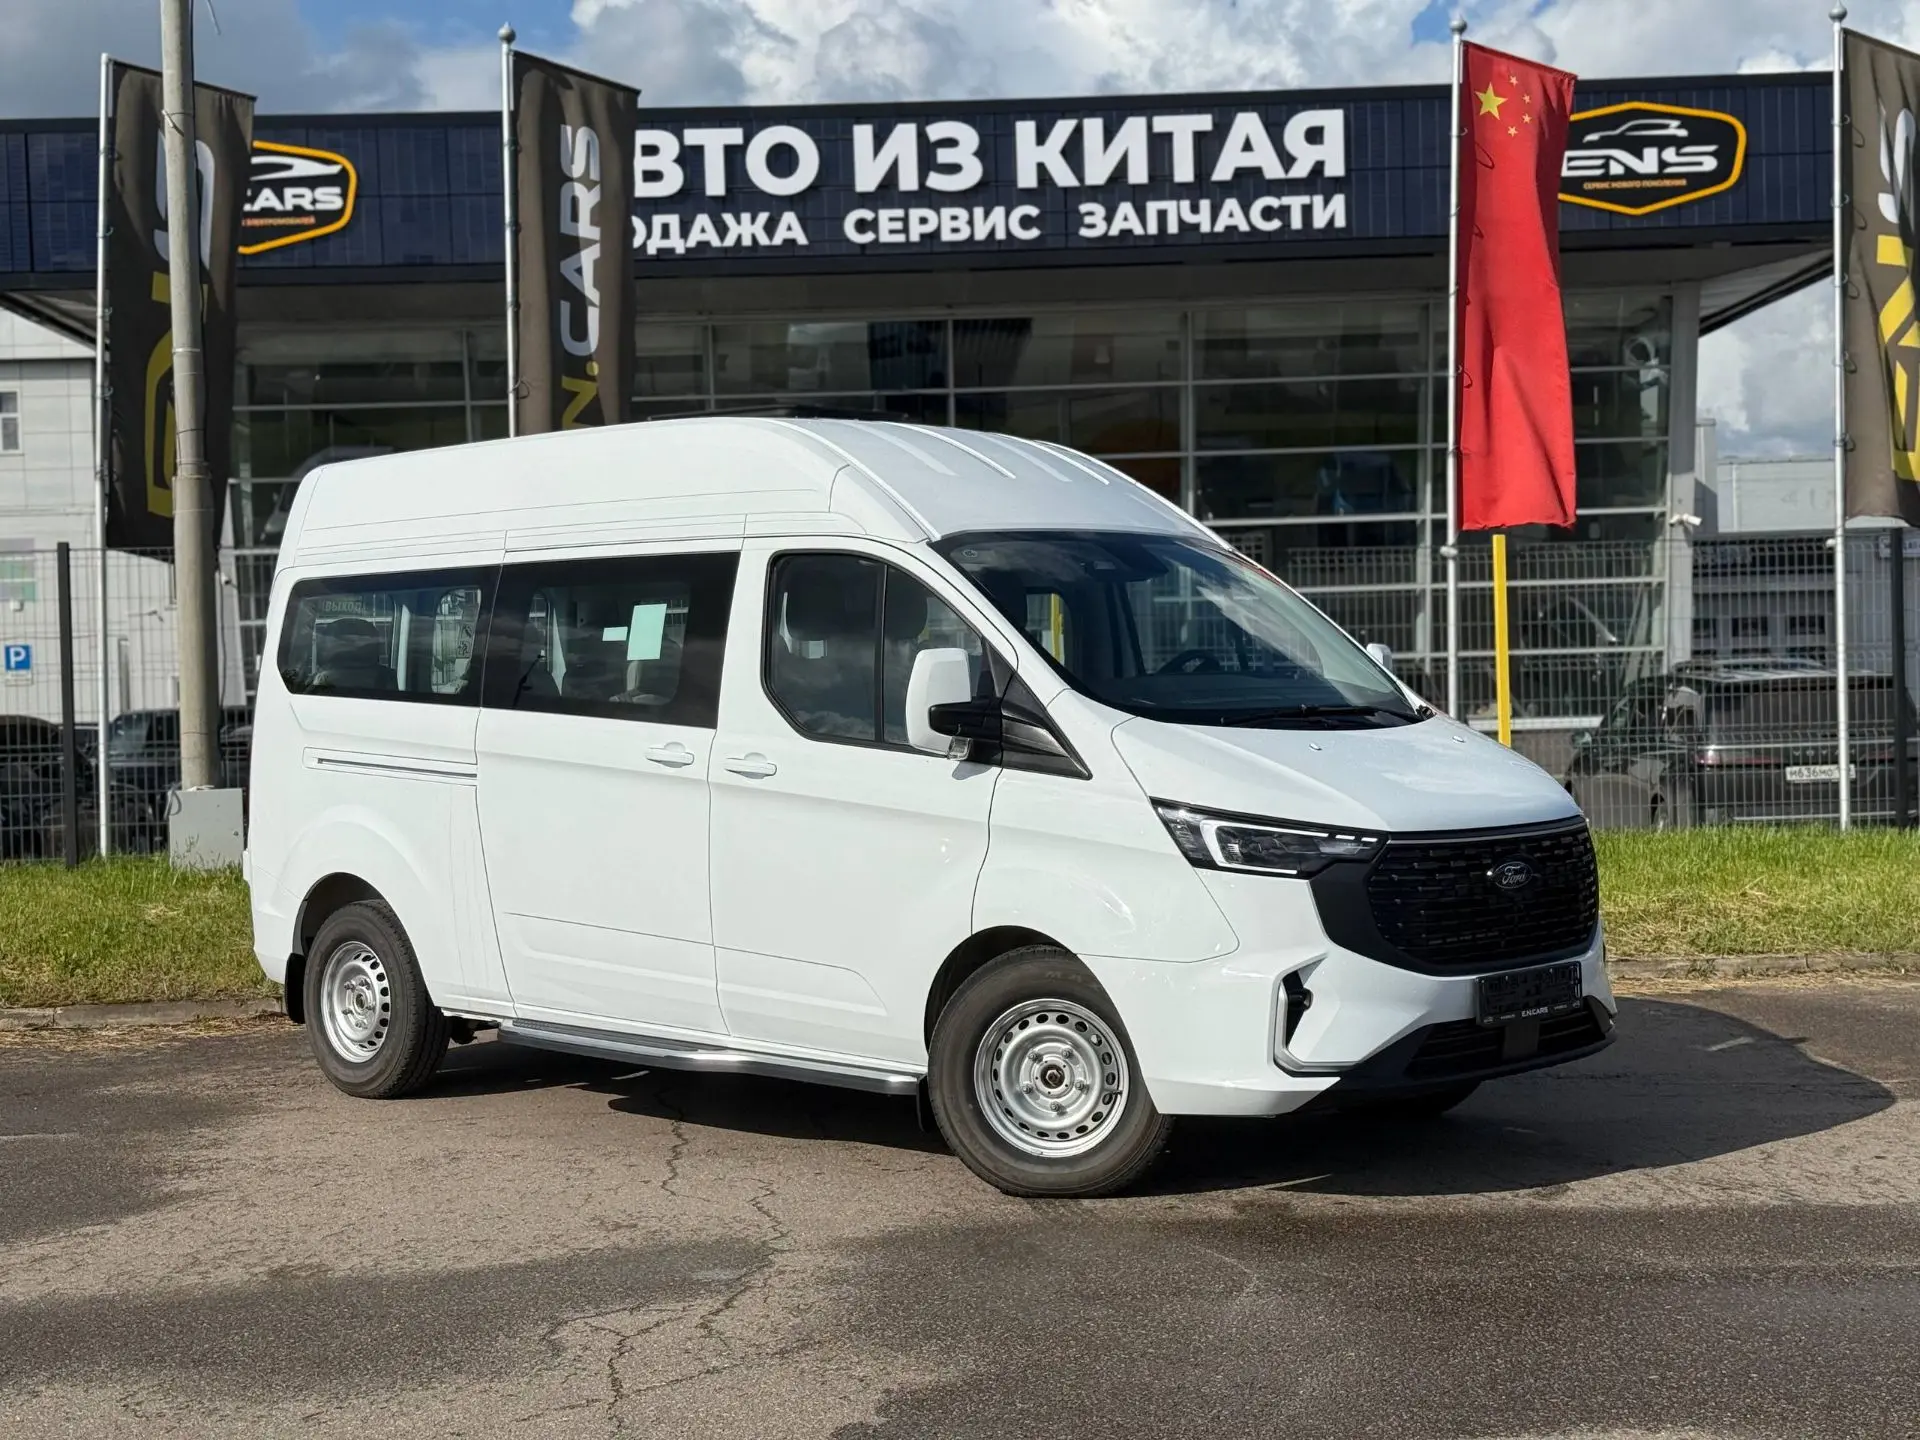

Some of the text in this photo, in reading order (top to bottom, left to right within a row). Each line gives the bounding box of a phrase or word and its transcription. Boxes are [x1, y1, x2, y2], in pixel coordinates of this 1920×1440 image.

[852, 120, 983, 193] ИЗ
[1015, 108, 1346, 189] КИТАЯ
[1561, 144, 1719, 177] ENS
[843, 204, 1041, 244] СЕРВИС
[1078, 193, 1346, 238] ЗАПЧАСТИ
[9, 647, 26, 669] P
[1502, 865, 1527, 884] Ford
